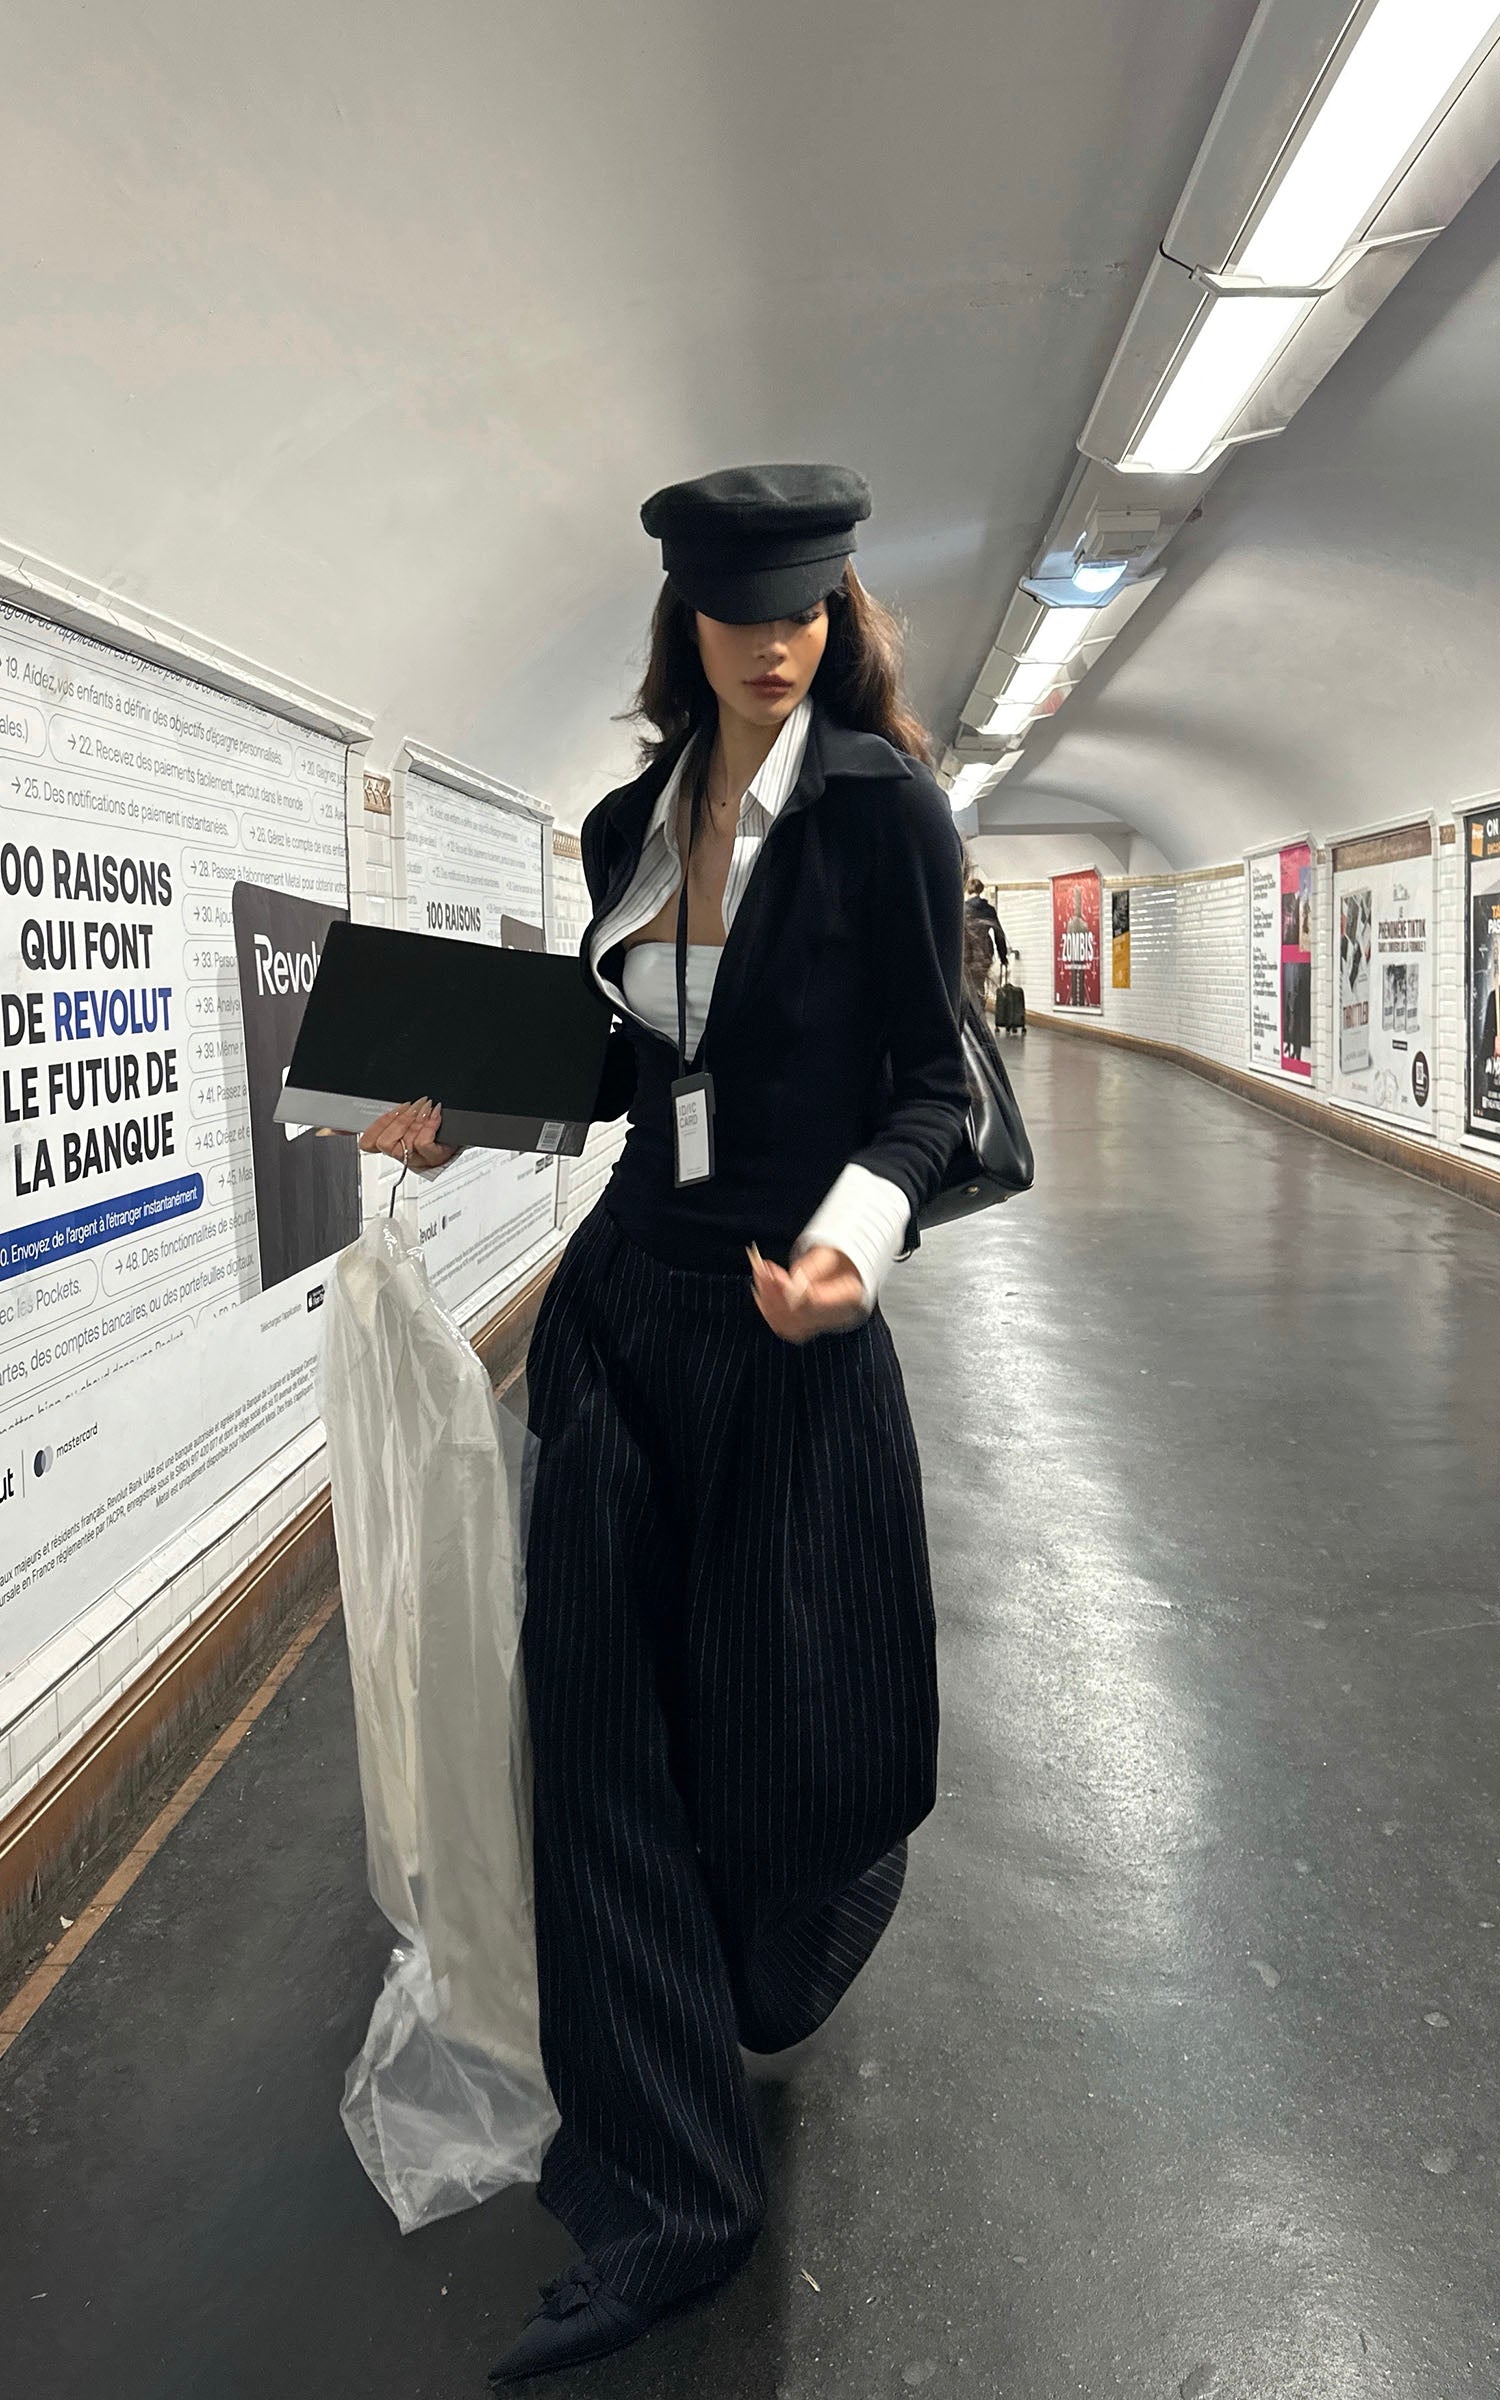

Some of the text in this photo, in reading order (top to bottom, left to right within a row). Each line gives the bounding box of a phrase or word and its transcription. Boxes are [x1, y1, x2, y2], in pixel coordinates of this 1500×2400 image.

[6, 656, 20, 680] 19.
[76, 684, 114, 710] enfants
[115, 694, 122, 712] à
[124, 697, 151, 721] définir
[153, 707, 168, 728] des
[169, 713, 205, 741] objectifs
[79, 735, 94, 757] 22.
[96, 739, 134, 767] Recevez
[136, 751, 152, 772] des
[153, 759, 195, 784] paiements
[236, 781, 259, 801] partout
[25, 777, 41, 800] 25.
[44, 780, 65, 804] Des
[67, 789, 125, 815] notifications
[127, 800, 139, 818] de
[141, 805, 180, 826] paiement
[53, 848, 172, 906] RAISONS
[211, 861, 236, 881] Passez
[202, 906, 213, 923] 30.
[427, 901, 443, 930] 100
[445, 903, 481, 932] RAISONS
[21, 918, 153, 971] QUI FONT
[254, 933, 321, 996] Revol
[1062, 931, 1094, 962] ZOMBIS
[1, 987, 172, 1047] DE REVOLUT
[3, 1049, 178, 1124] LE FUTUR DE
[679, 1113, 698, 1129] CARD
[14, 1111, 175, 1197] LA BANQUE
[11, 1237, 50, 1263] Envoyez
[52, 1230, 64, 1249] de
[65, 1221, 98, 1245] l'argent
[99, 1215, 106, 1232] à
[106, 1206, 142, 1231] l'étranger
[141, 1185, 198, 1216] instantanément
[126, 1251, 140, 1272] 48.
[142, 1247, 159, 1267] Des
[160, 1221, 217, 1259] fonctionnalités
[218, 1217, 228, 1234] de
[36, 1279, 82, 1311] Pockets.
[31, 1348, 52, 1371] des
[55, 1325, 100, 1359] comptes
[102, 1303, 148, 1337] bancaires,
[149, 1298, 161, 1314] ou
[163, 1287, 178, 1307] des
[56, 1421, 98, 1458] mastercard
[14, 1548, 41, 1577] majeurs
[42, 1541, 50, 1556] et
[50, 1521, 80, 1550] résidents
[107, 1486, 128, 1509] Revolut
[129, 1476, 143, 1495] Bank
[22, 1575, 31, 1591] en
[32, 1558, 55, 1583] France
[56, 1528, 95, 1564] réglementée
[95, 1521, 105, 1539] par
